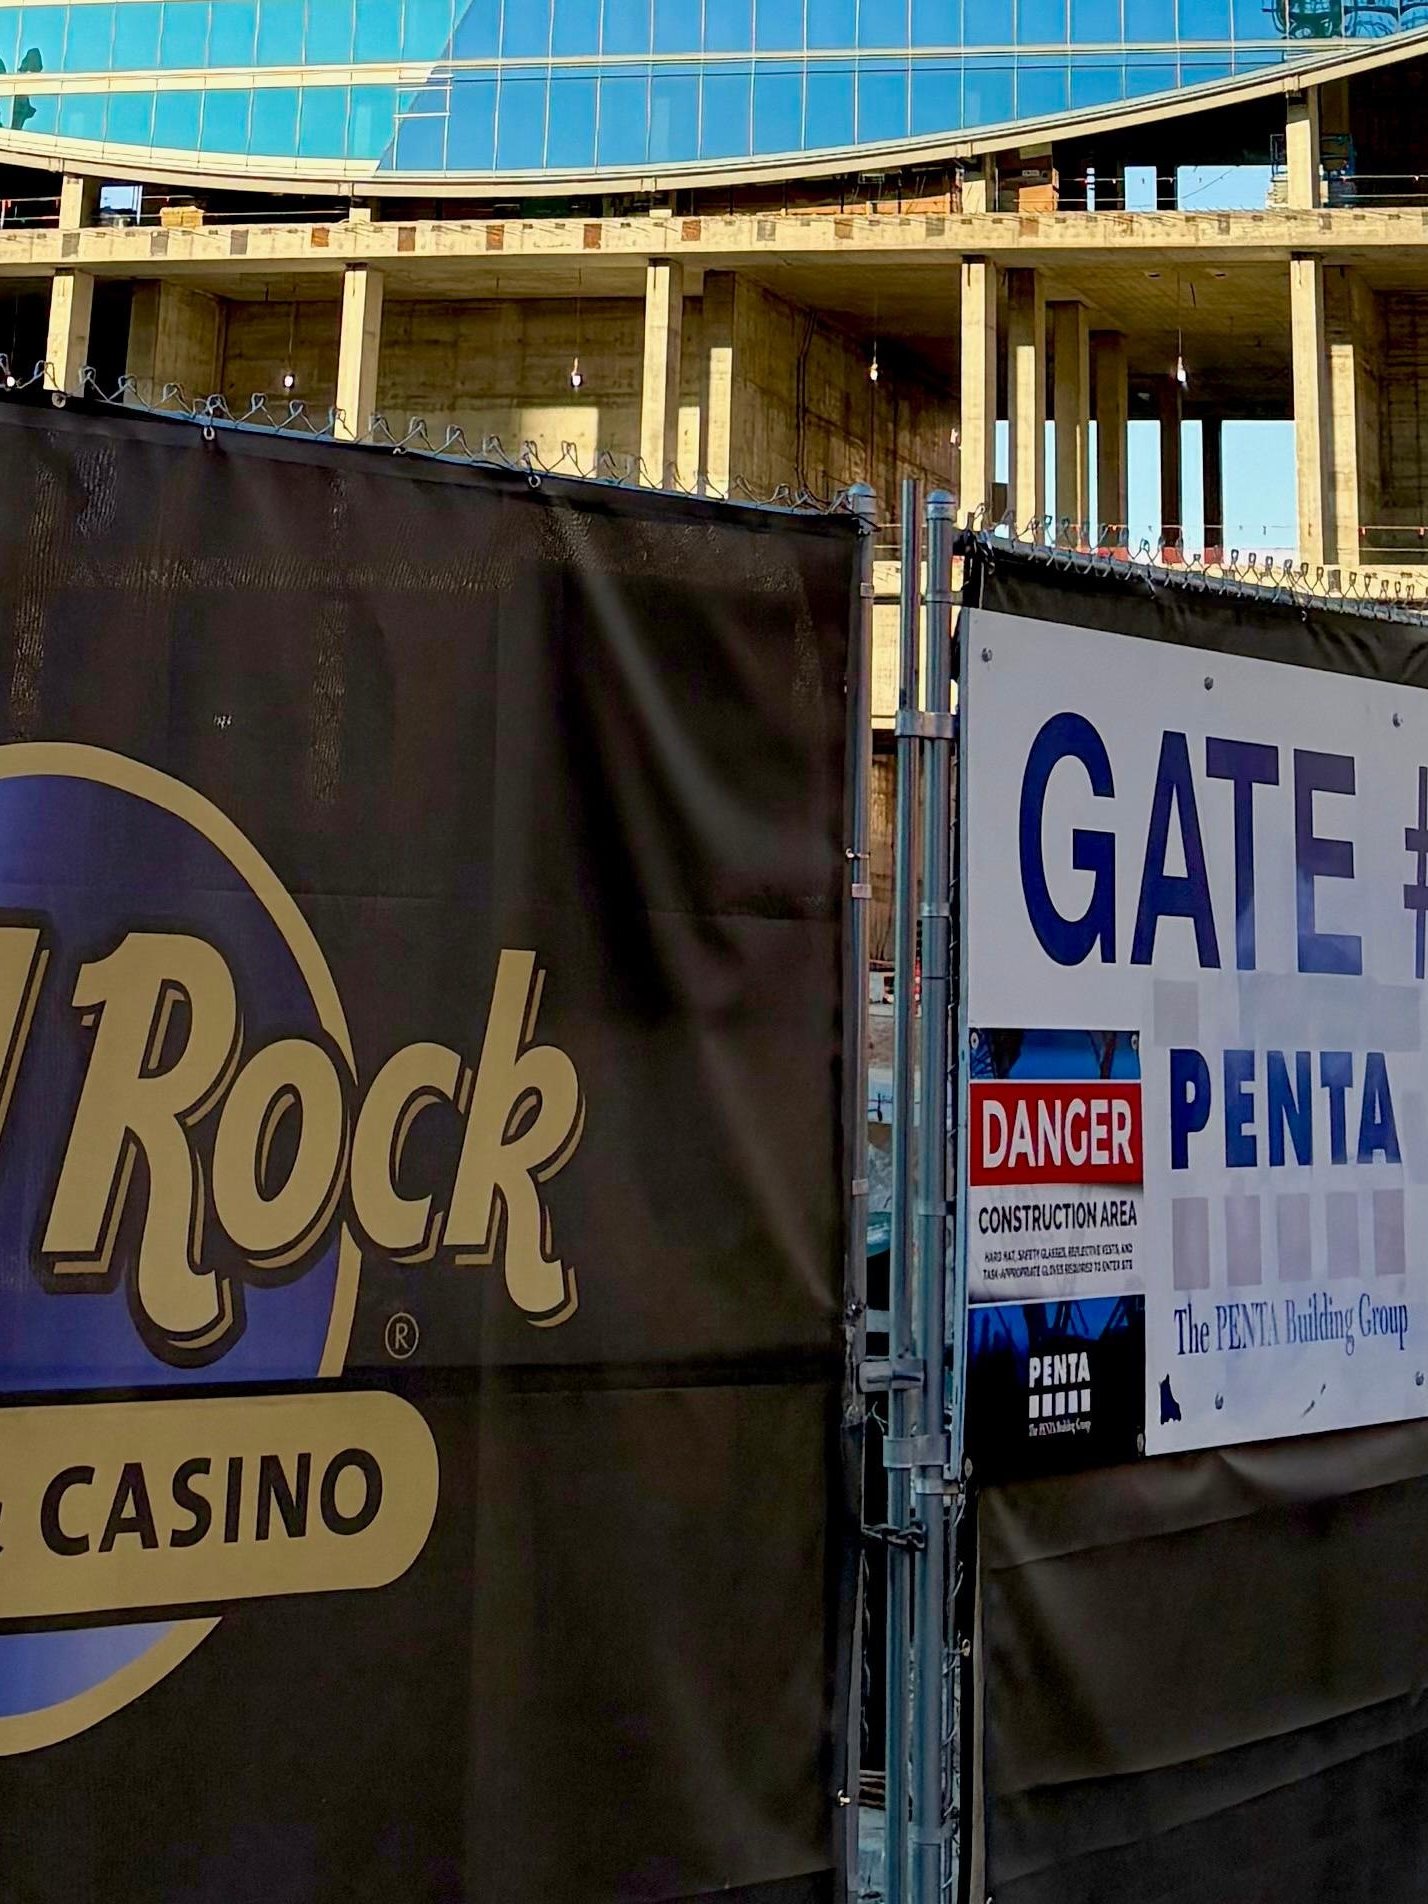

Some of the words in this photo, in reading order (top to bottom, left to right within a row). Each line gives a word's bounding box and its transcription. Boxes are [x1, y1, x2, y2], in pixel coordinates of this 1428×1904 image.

[1018, 711, 1363, 975] GATE
[42, 932, 584, 1348] Rock
[983, 1098, 1134, 1168] DANGER
[1170, 1048, 1402, 1170] PENTA
[979, 1202, 1097, 1234] CONSTRUCTION
[1100, 1201, 1137, 1227] AREA
[1174, 1299, 1209, 1356] The
[1215, 1301, 1279, 1351] PENTA
[1284, 1292, 1355, 1356] Building
[1358, 1293, 1408, 1350] Group
[1029, 1352, 1090, 1388] PENTA
[40, 1447, 383, 1557] CASINO
